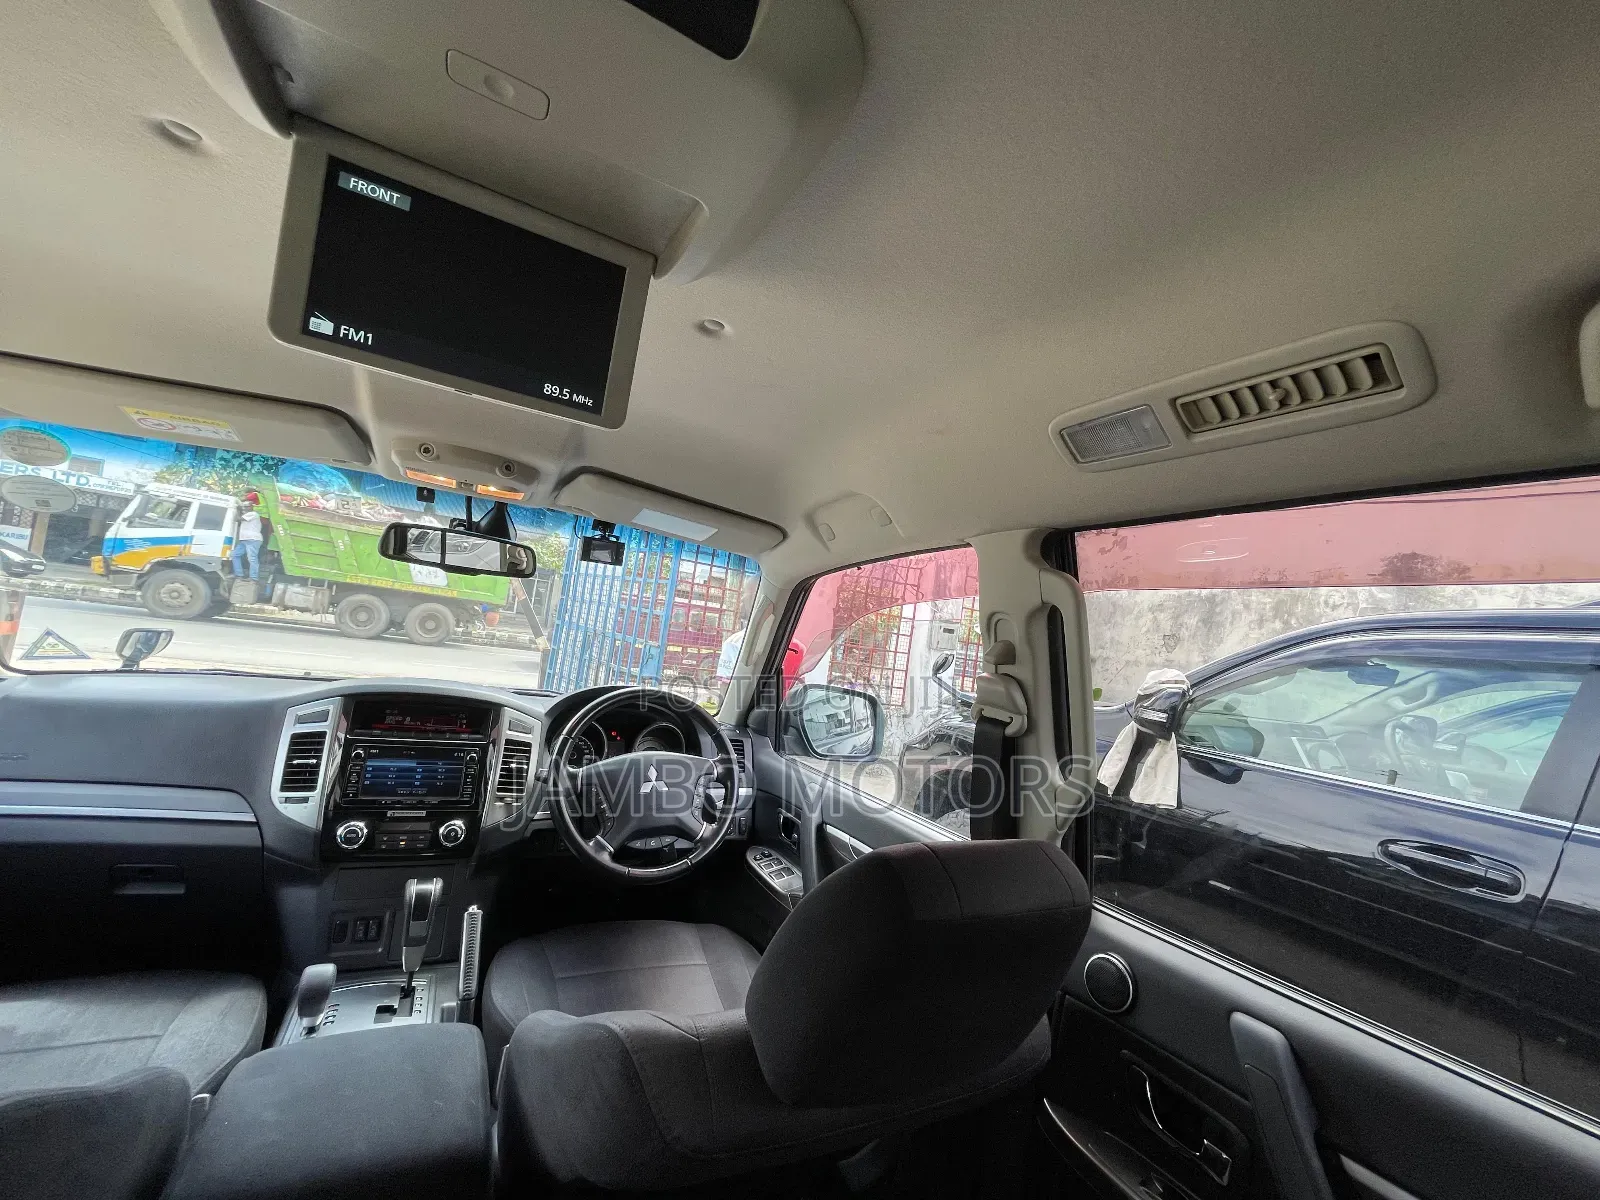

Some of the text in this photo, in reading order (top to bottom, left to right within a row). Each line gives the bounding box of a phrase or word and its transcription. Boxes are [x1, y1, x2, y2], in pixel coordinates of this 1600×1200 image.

[349, 177, 401, 206] FRONT
[339, 324, 373, 346] FM1
[543, 382, 594, 407] 89.5 MHz
